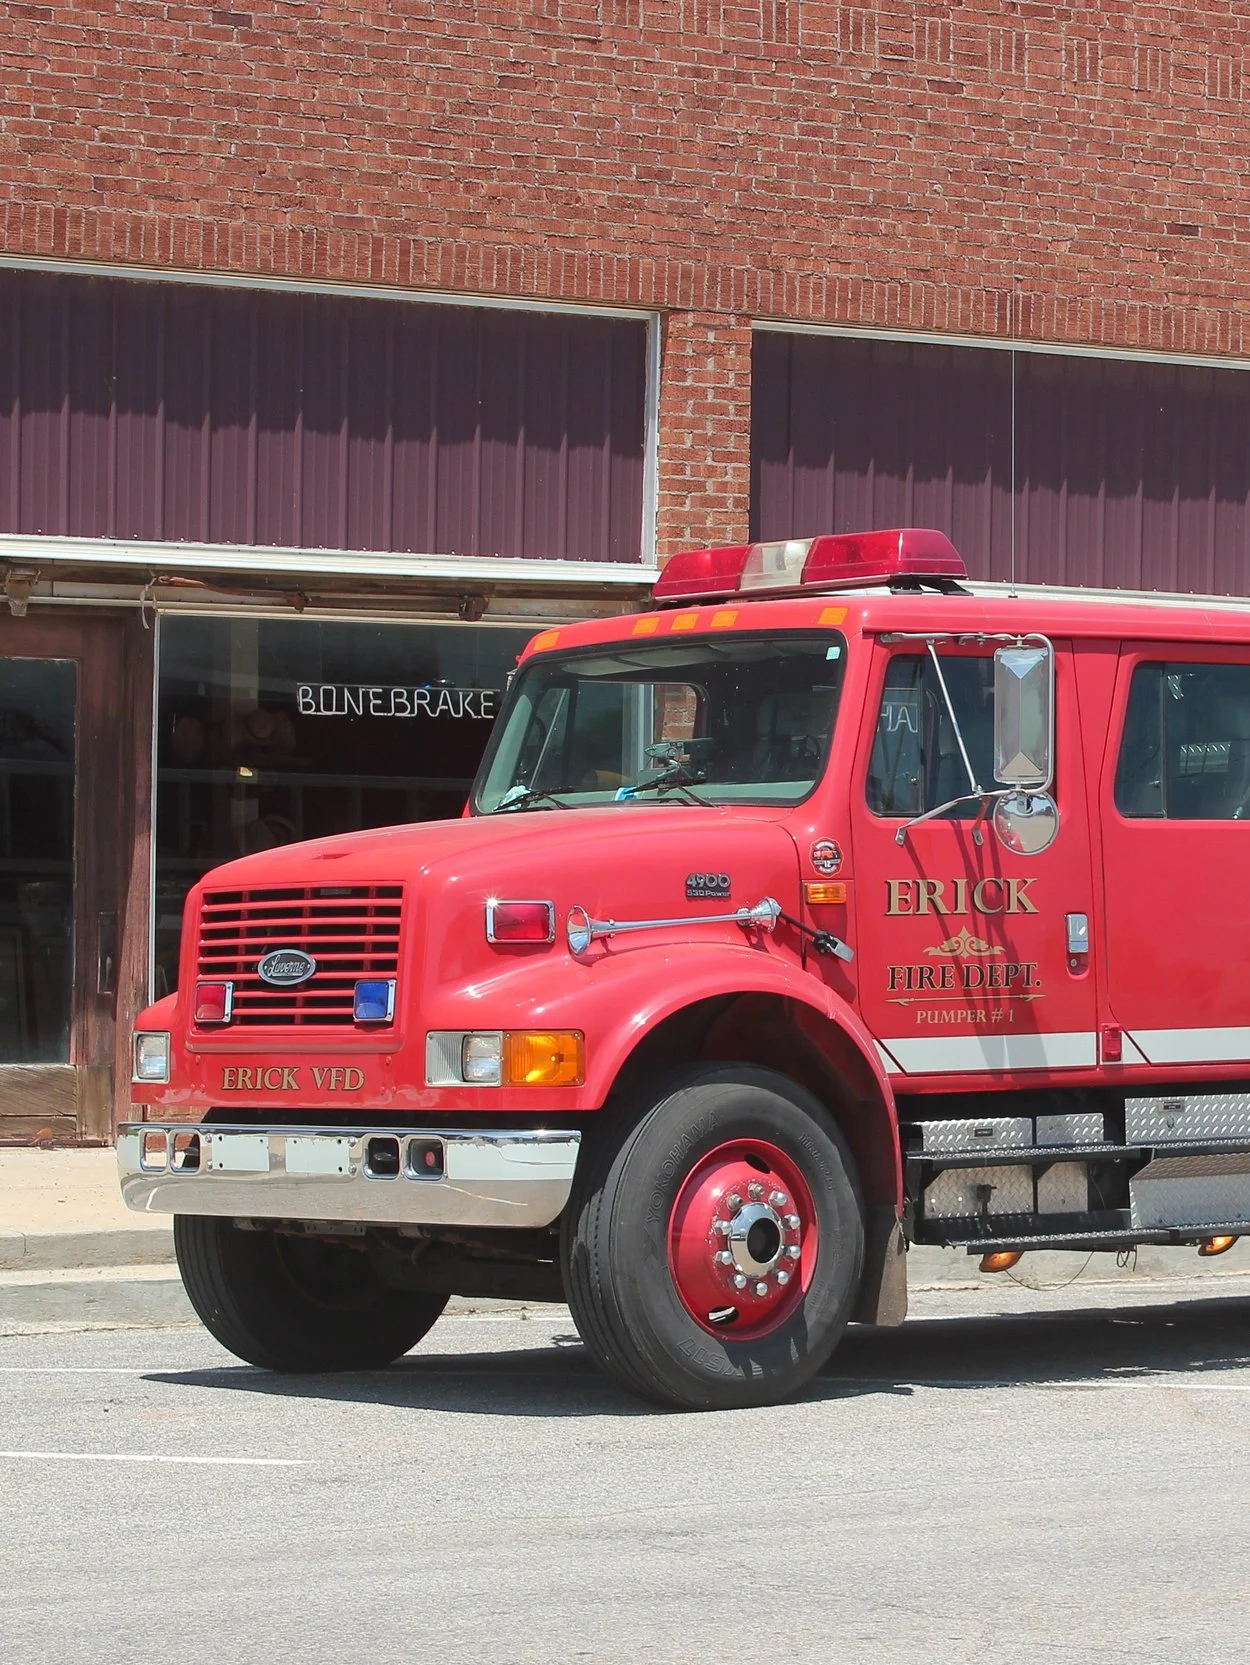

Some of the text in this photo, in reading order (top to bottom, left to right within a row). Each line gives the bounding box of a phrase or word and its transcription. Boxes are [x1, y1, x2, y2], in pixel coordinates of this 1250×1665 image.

[298, 685, 494, 718] BONEBRAKE
[686, 873, 731, 888] 4900
[705, 889, 731, 897] Power
[884, 877, 1040, 916] ERICK
[886, 962, 1042, 991] FIRE DEPT.
[915, 1007, 1014, 1024] PUMPER # 1
[222, 1066, 366, 1091] ERICK VFD
[645, 1109, 721, 1224] YOKOHAMA
